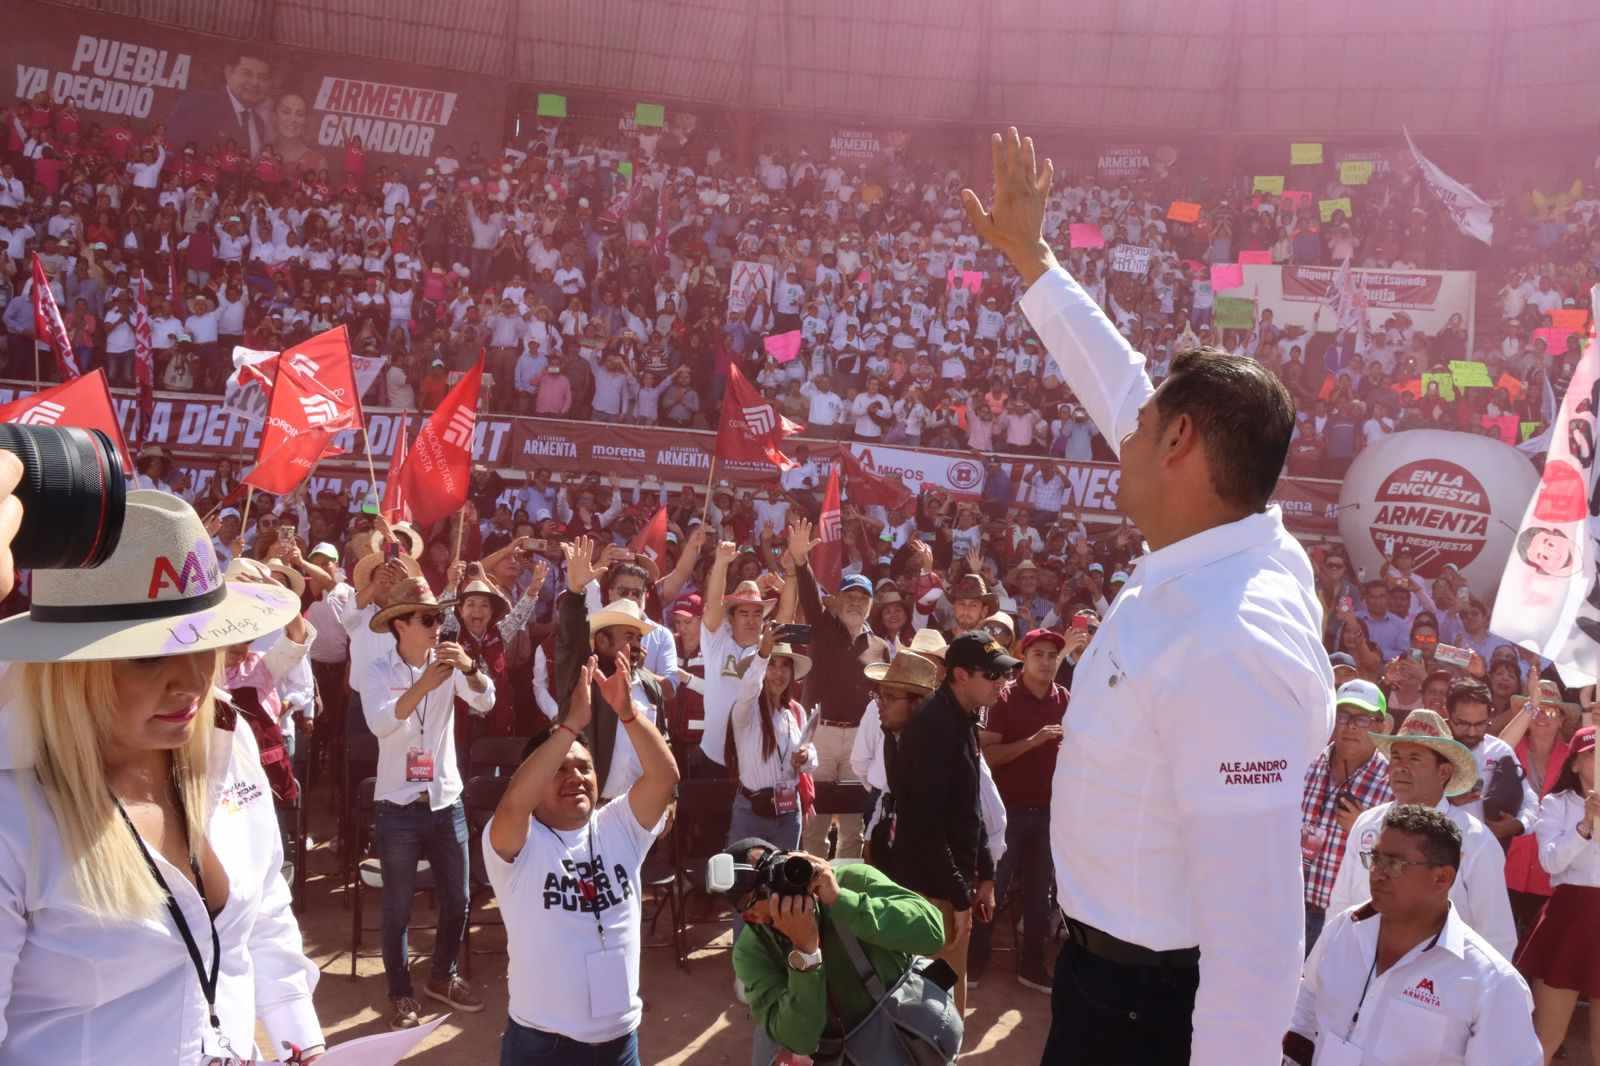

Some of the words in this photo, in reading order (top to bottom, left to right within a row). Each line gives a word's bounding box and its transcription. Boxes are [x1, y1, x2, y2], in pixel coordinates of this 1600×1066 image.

[72, 34, 192, 90] PUEBLA
[15, 64, 49, 99] YA
[326, 79, 446, 123] ARMENTA
[318, 113, 435, 157] GANADOR
[1098, 155, 1150, 168] ARMENTA
[523, 439, 577, 458] ARMENTA
[592, 444, 646, 458] morena
[657, 450, 710, 468] ARMENTA
[1409, 470, 1438, 483] EN
[1438, 473, 1463, 487] LA
[1387, 482, 1481, 506] ENCUESTA
[1374, 505, 1489, 536] ARMENTA
[1219, 760, 1288, 773] ALEJANDRO
[1225, 772, 1283, 785] ARMENTA
